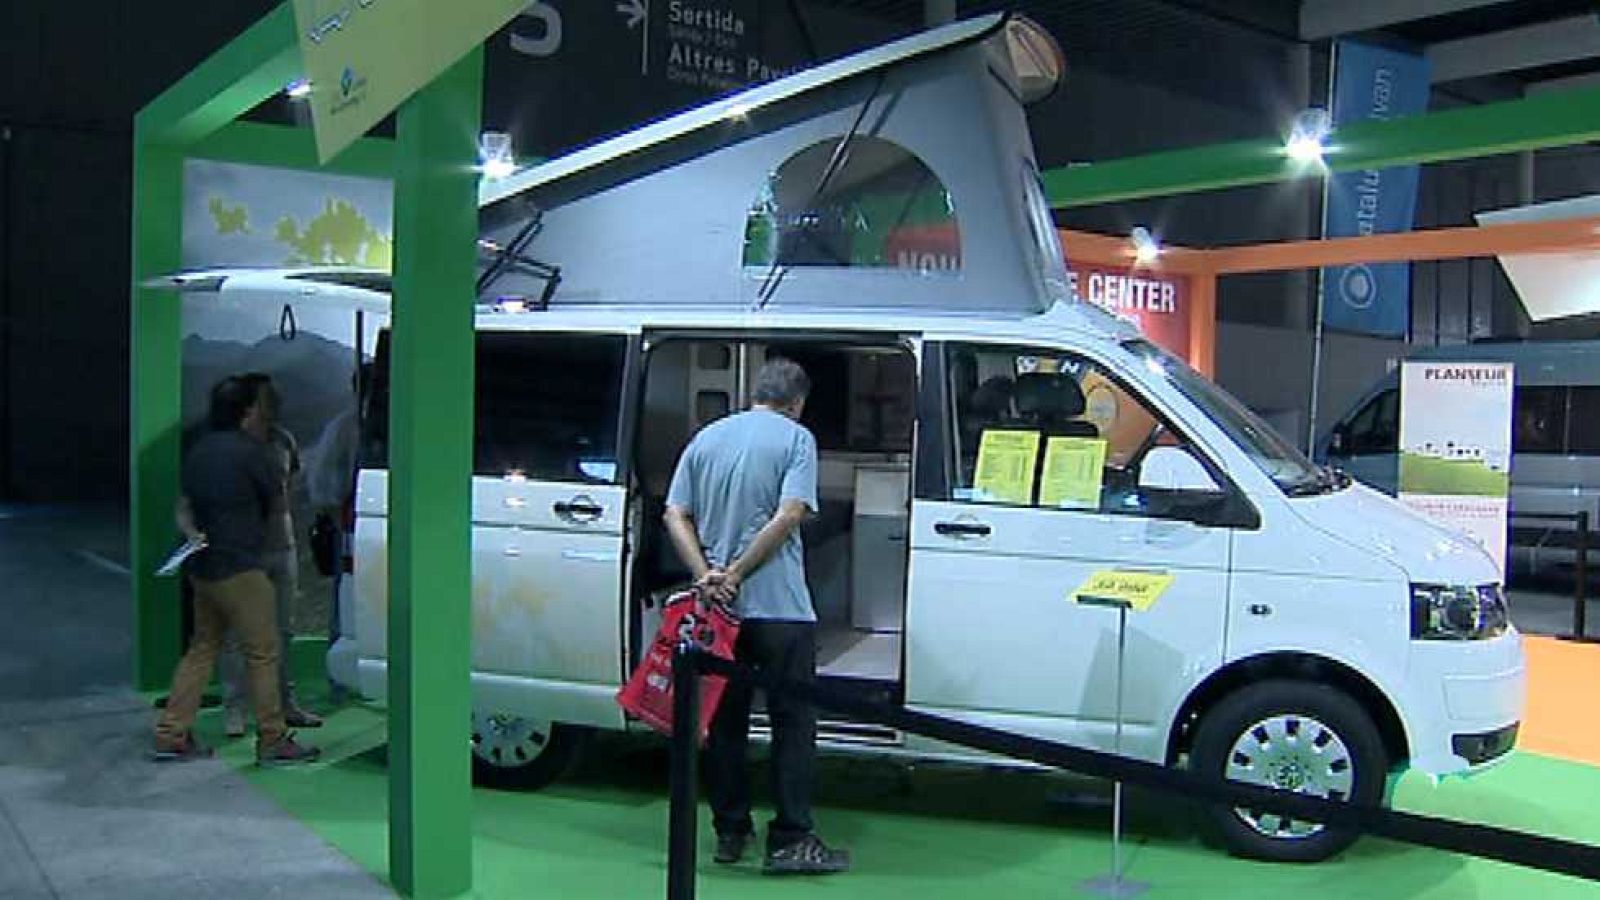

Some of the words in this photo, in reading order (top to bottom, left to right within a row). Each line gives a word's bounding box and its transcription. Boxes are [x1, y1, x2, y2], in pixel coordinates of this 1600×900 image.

[668, 0, 744, 35] Sortida
[668, 42, 735, 74] Altres
[1088, 272, 1175, 313] CENTER
